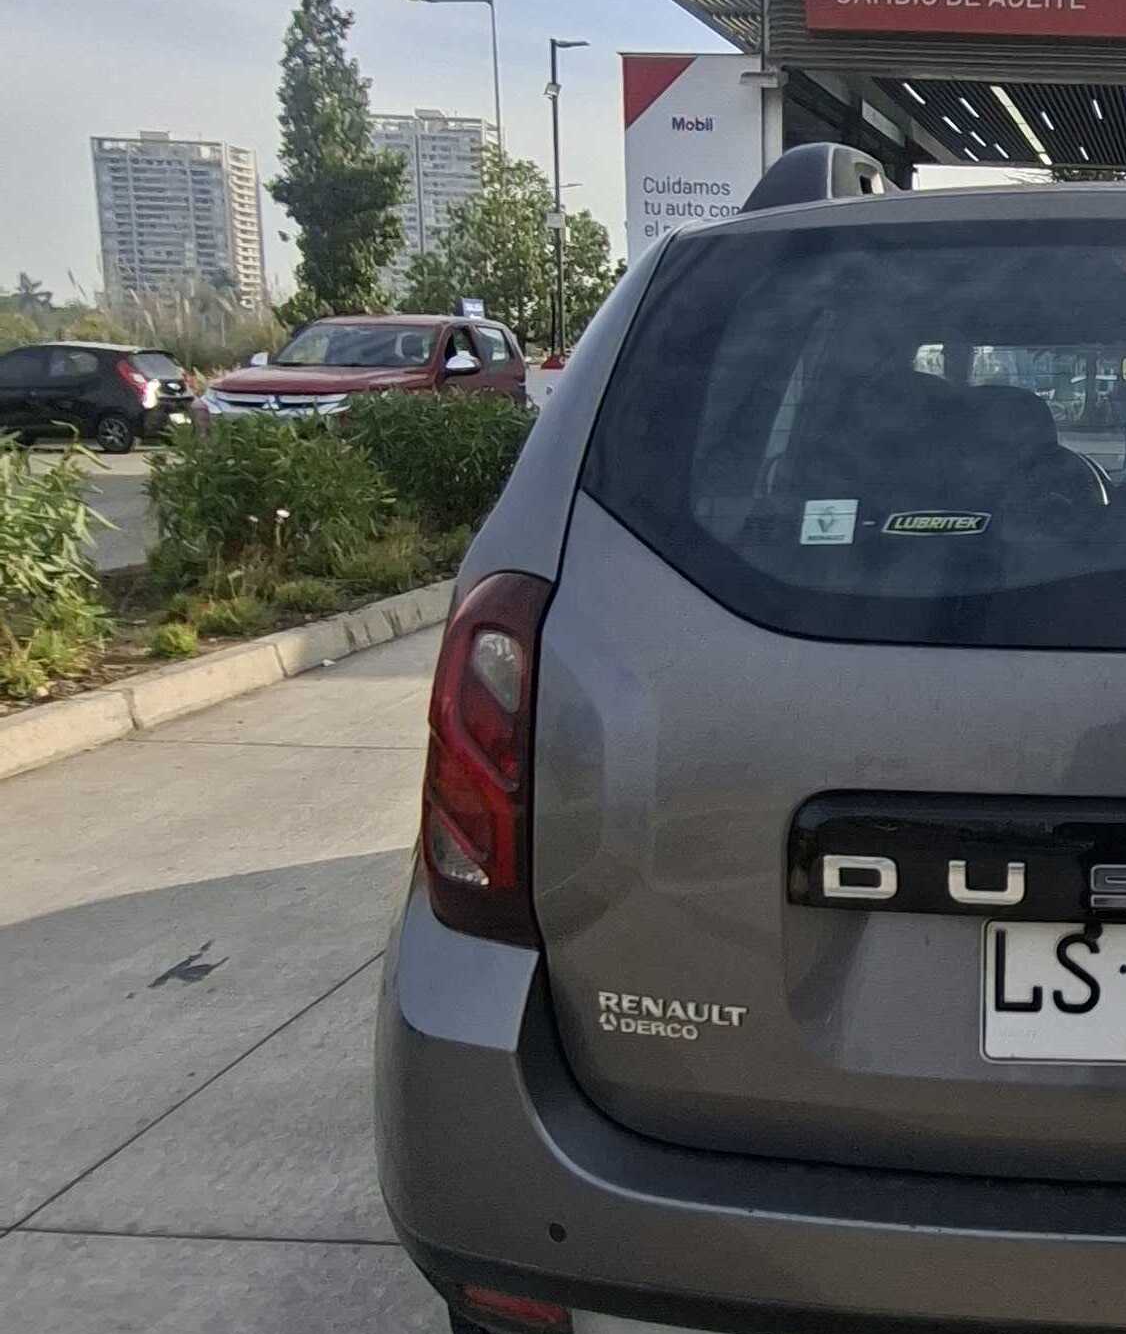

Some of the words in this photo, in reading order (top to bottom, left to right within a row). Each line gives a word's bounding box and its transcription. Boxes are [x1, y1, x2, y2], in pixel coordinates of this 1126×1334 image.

[671, 117, 713, 131] Mobil
[643, 176, 731, 196] Cuidamos
[643, 199, 662, 216] tu
[665, 200, 706, 218] auto
[643, 221, 659, 238] el
[894, 517, 981, 530] LUBRITEK
[599, 990, 748, 1027] RENAULT
[620, 1017, 699, 1041] DERCO
